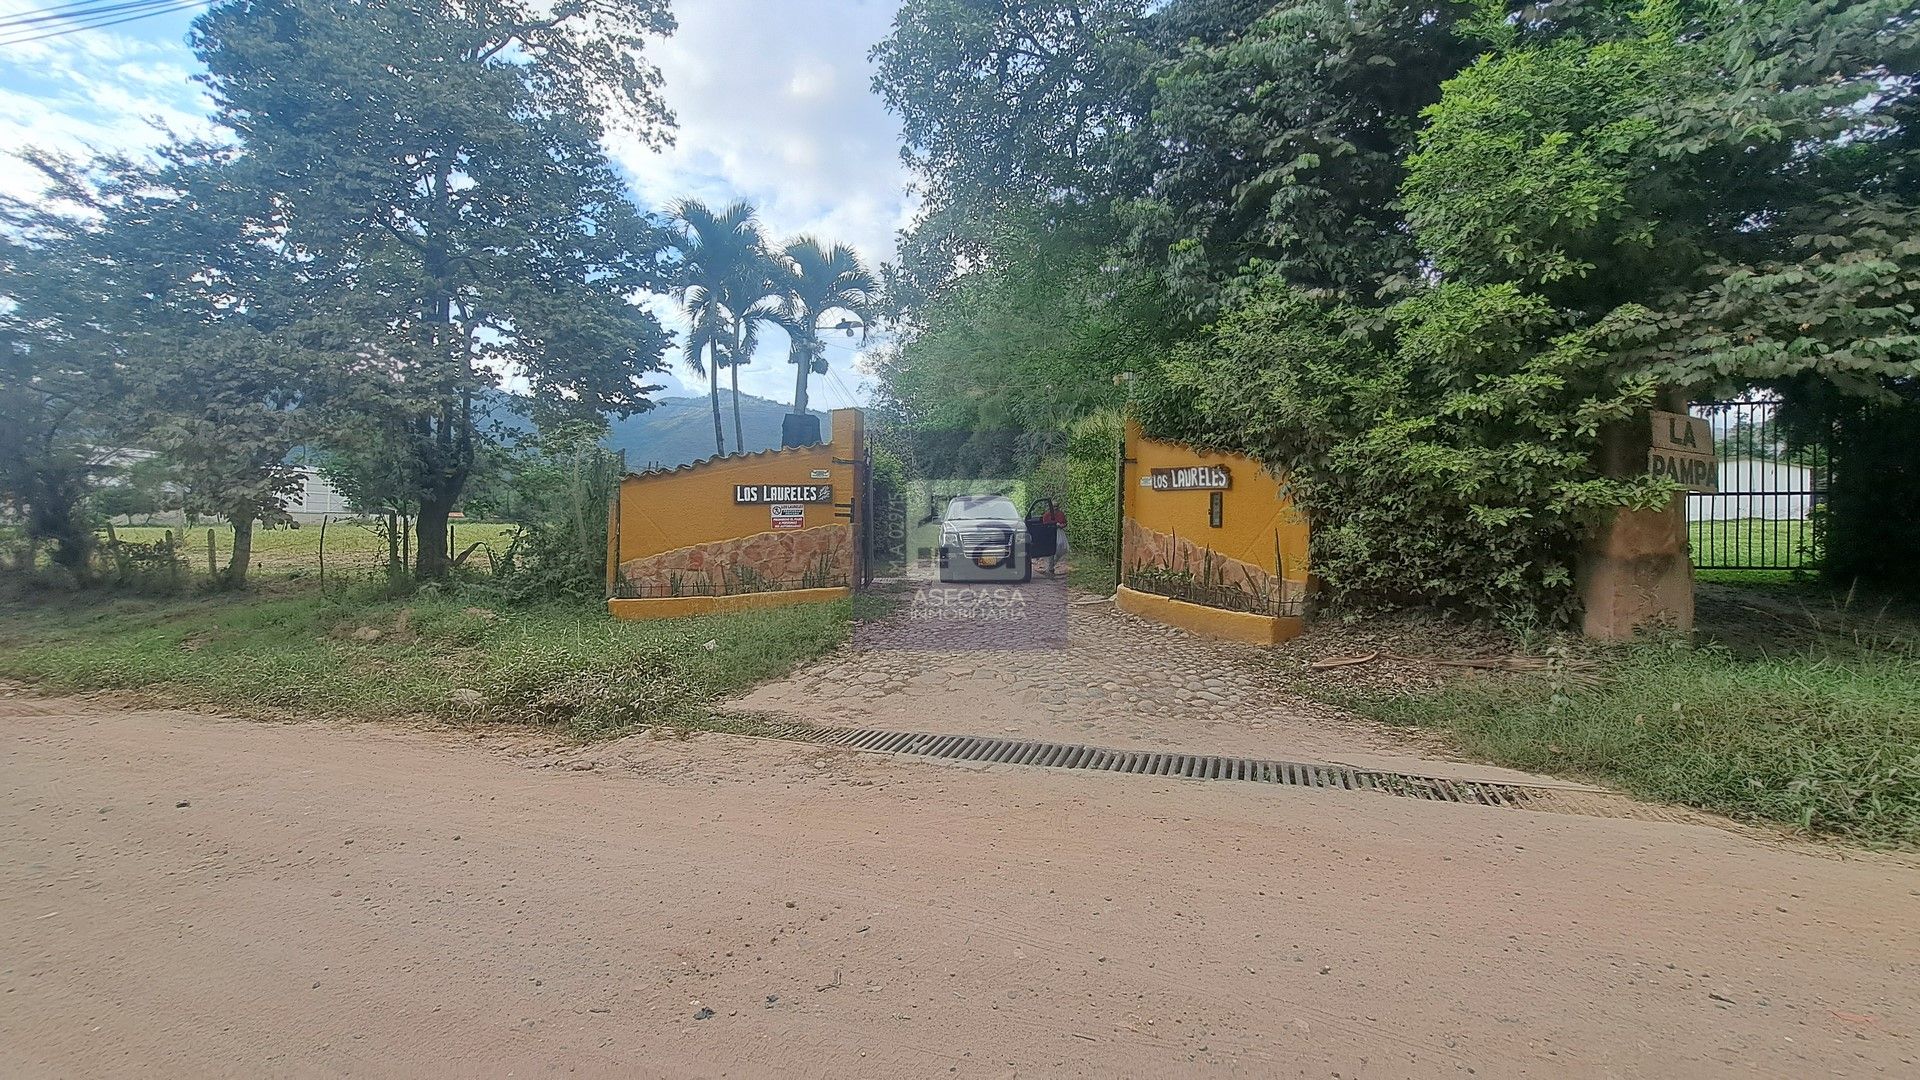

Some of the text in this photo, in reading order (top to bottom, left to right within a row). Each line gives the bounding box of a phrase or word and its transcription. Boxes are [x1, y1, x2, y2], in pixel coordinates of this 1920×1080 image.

[1669, 417, 1697, 448] LA
[1152, 475, 1168, 489] LOS
[1171, 467, 1226, 488] LAURELES
[1652, 454, 1716, 487] PAMPA
[737, 485, 817, 502] LOS LAURELES
